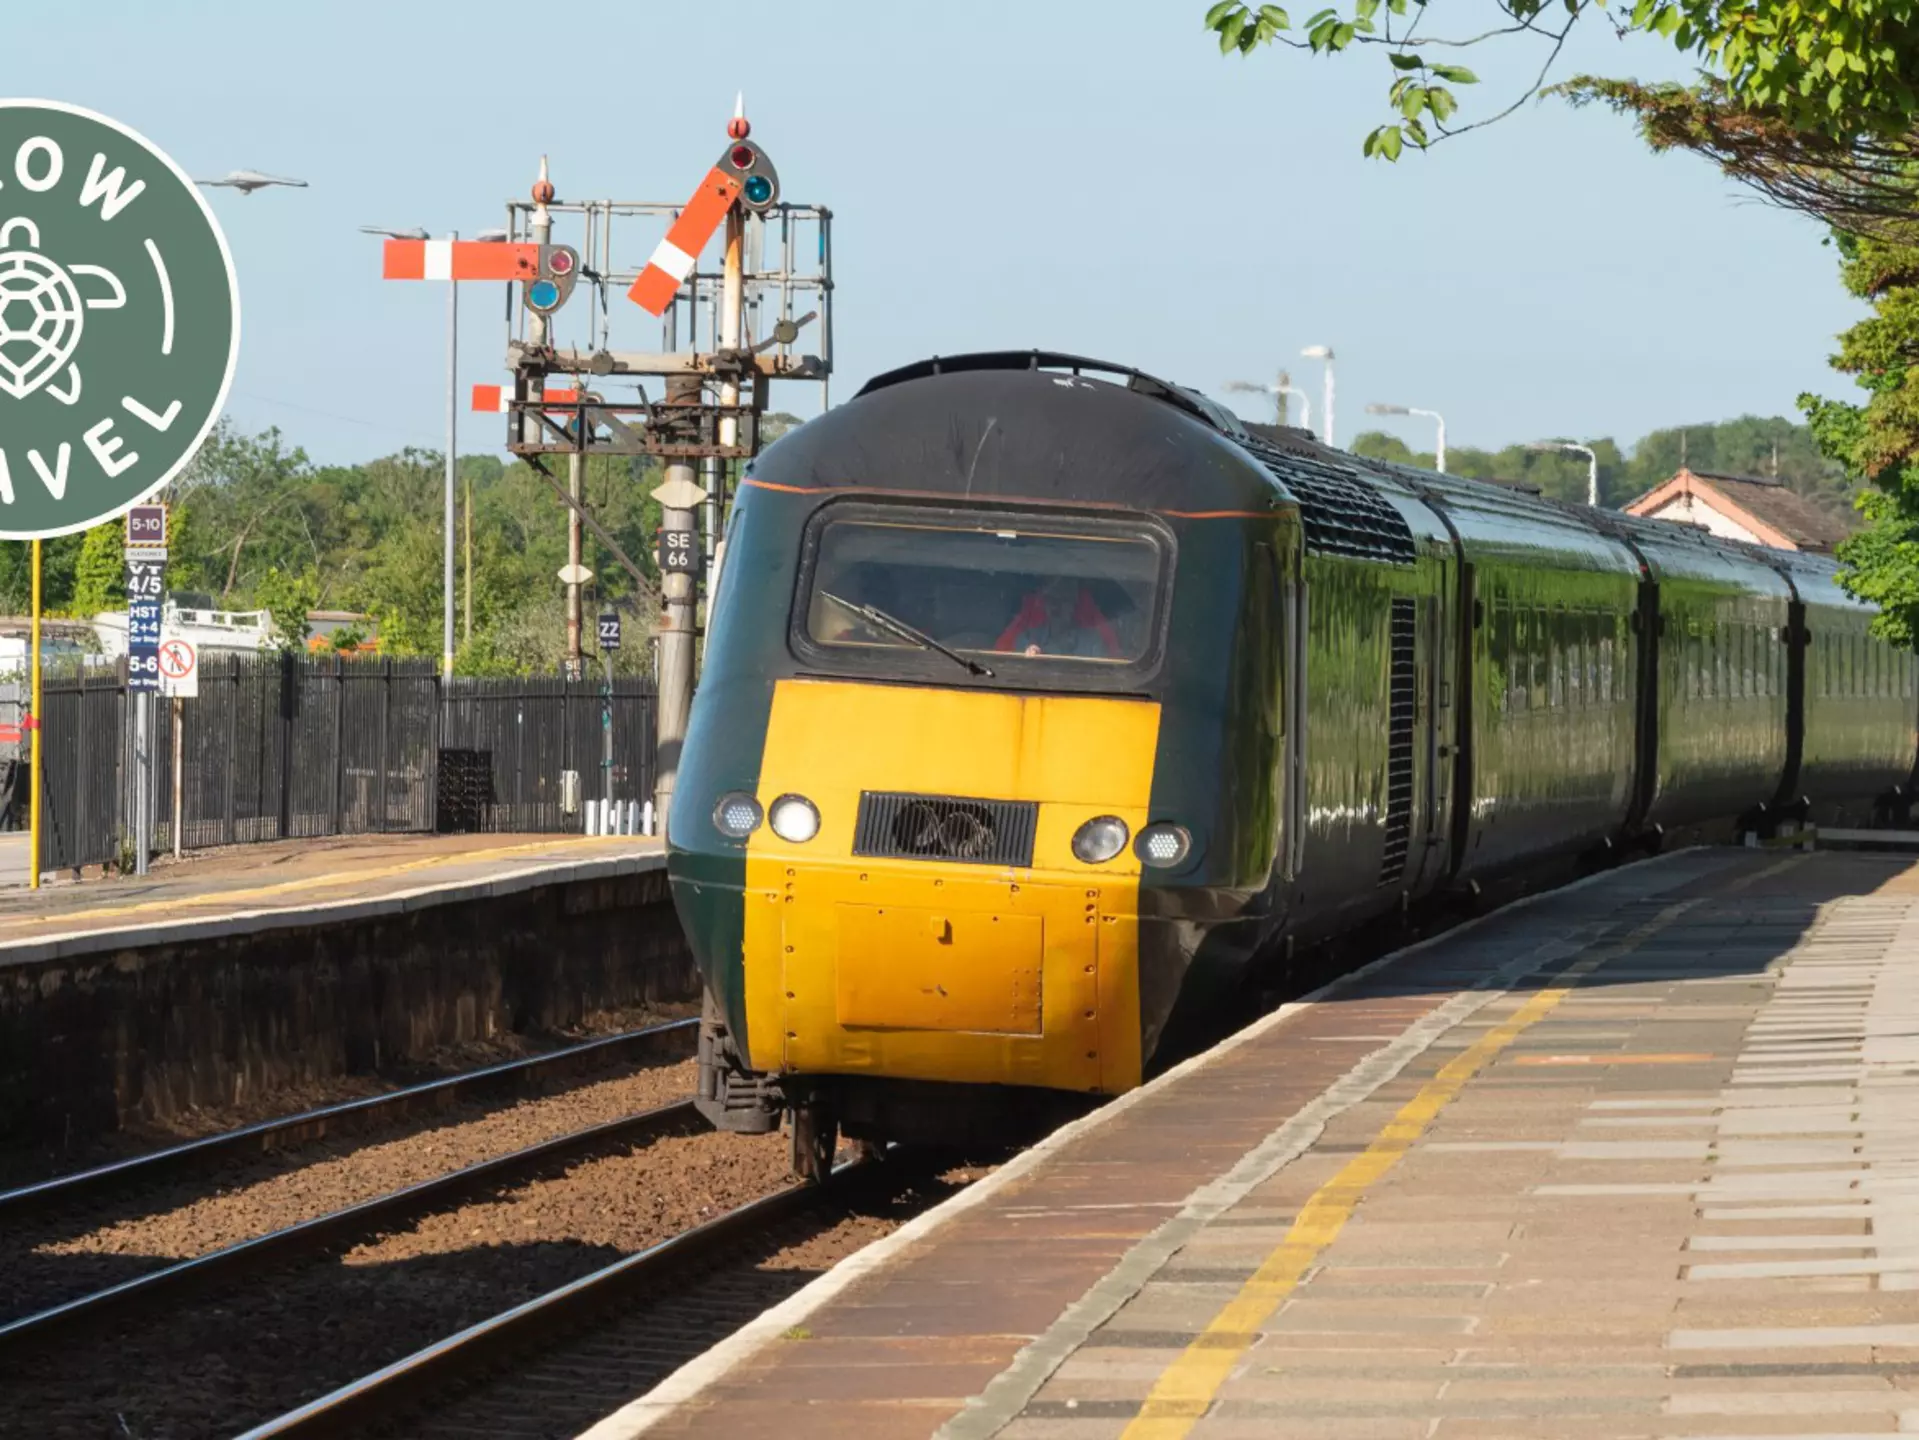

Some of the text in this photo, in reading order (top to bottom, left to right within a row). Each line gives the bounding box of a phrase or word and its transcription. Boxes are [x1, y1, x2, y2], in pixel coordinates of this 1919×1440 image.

[132, 518, 161, 532] 5-10
[667, 533, 690, 548] SE
[668, 552, 688, 566] 66
[128, 575, 161, 594] 4/5
[130, 606, 158, 619] HST
[130, 621, 158, 633] 2+4
[600, 622, 619, 637] ZZ
[129, 656, 158, 672] 5-6
